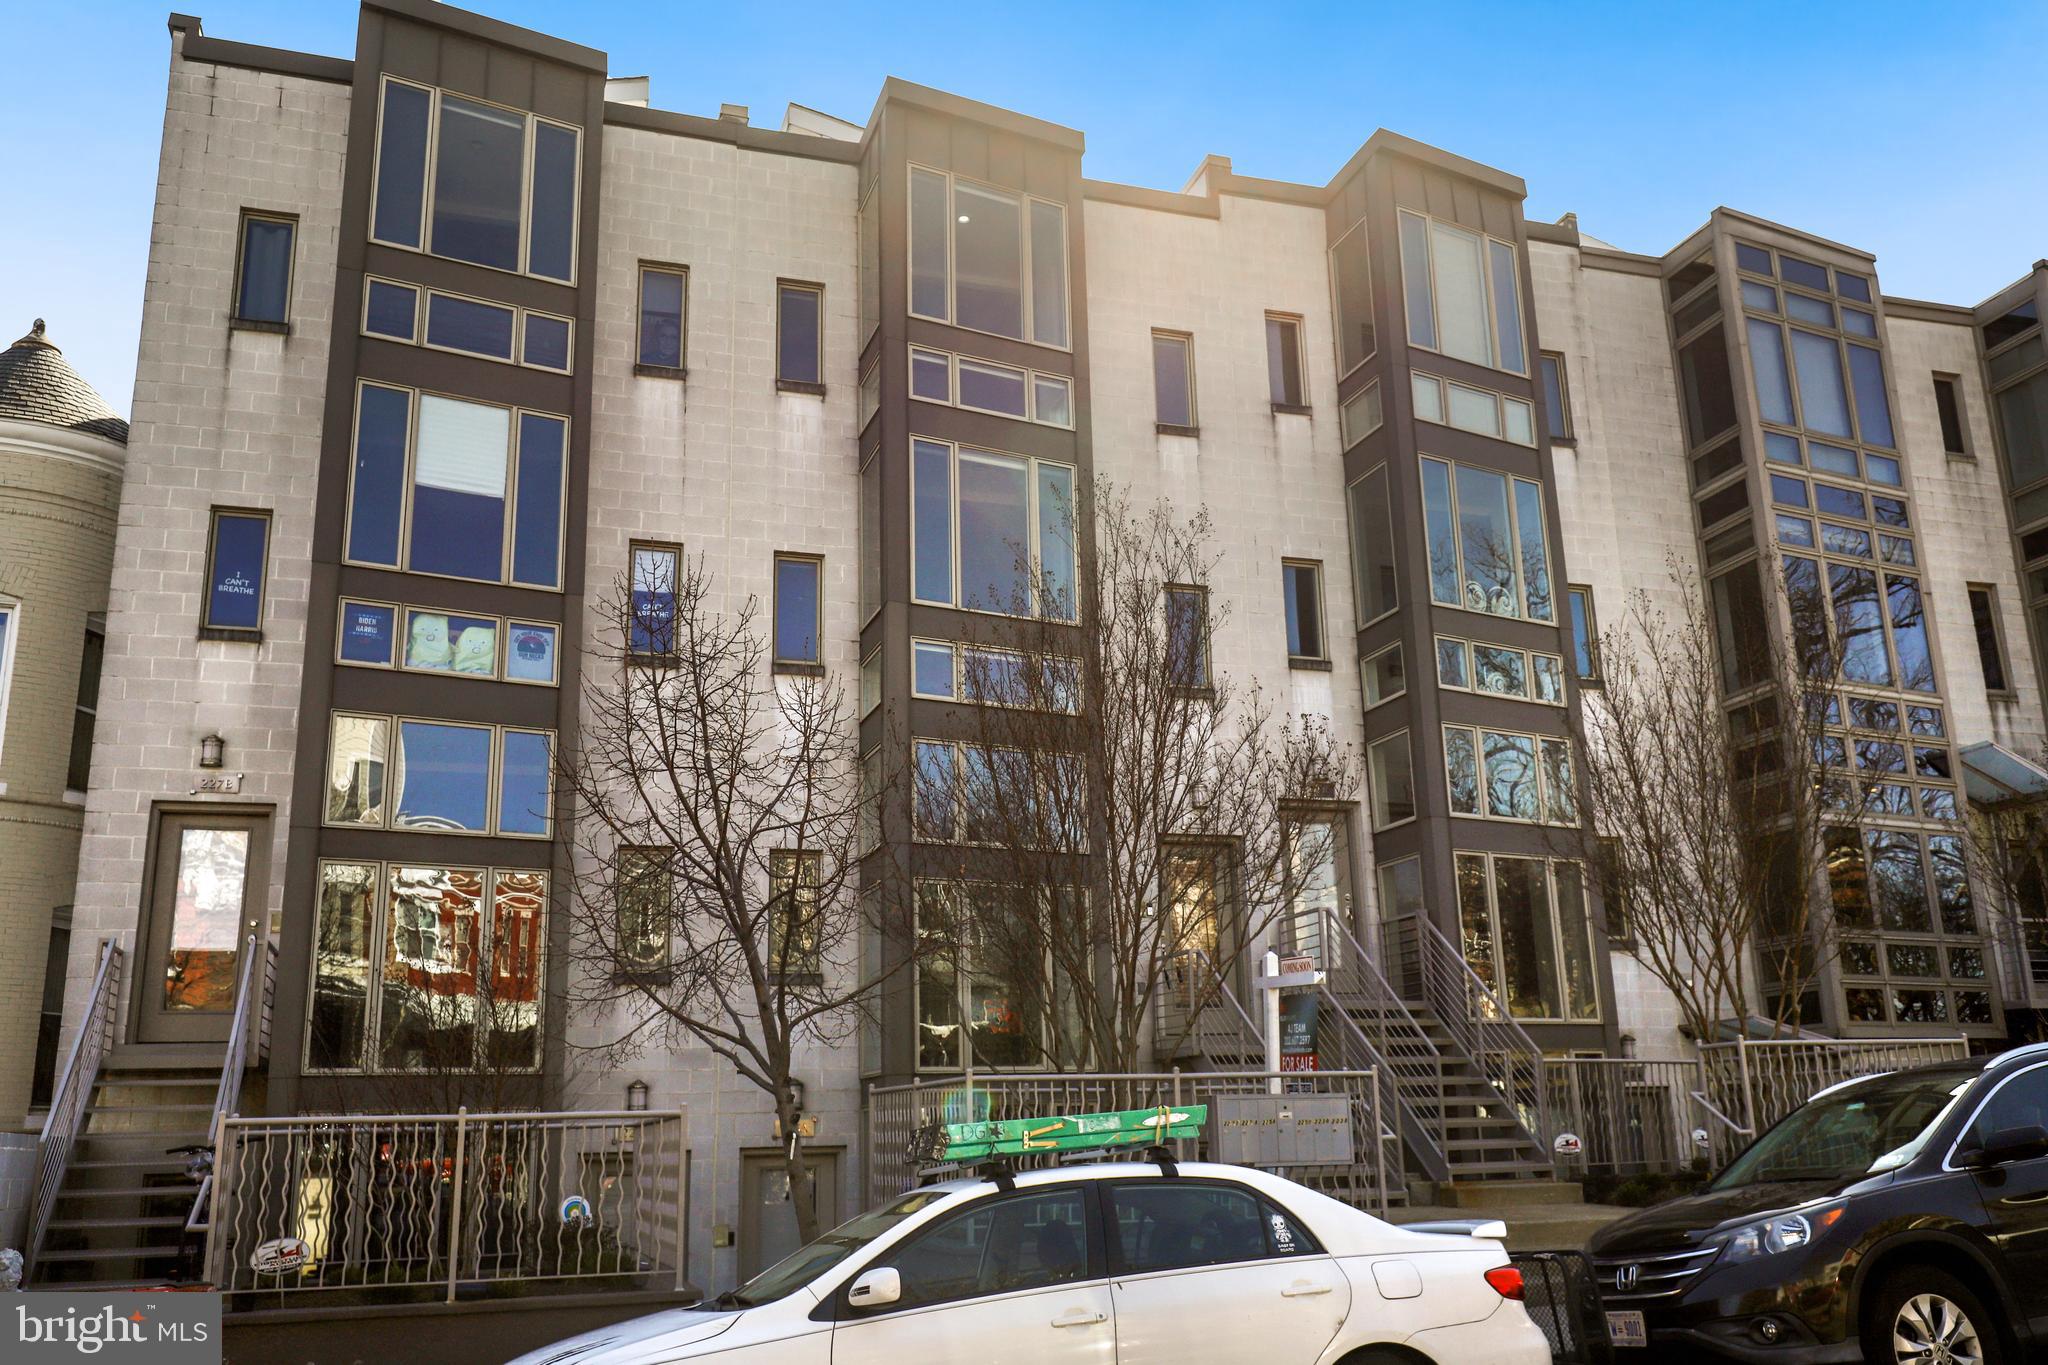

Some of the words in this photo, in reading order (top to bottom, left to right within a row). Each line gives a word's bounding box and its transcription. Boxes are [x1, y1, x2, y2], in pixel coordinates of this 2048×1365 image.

[225, 578, 250, 587] CAN'T
[218, 585, 254, 595] BREATHE
[358, 616, 377, 625] BIDEN
[355, 625, 378, 634] HARRIS
[200, 778, 233, 790] 227B
[1282, 963, 1299, 975] COMING
[1299, 961, 1312, 972] SOON
[1293, 1023, 1306, 1033] TEAM
[1282, 1056, 1295, 1072] FOR
[1296, 1056, 1313, 1072] SALE
[961, 1124, 986, 1141] DG
